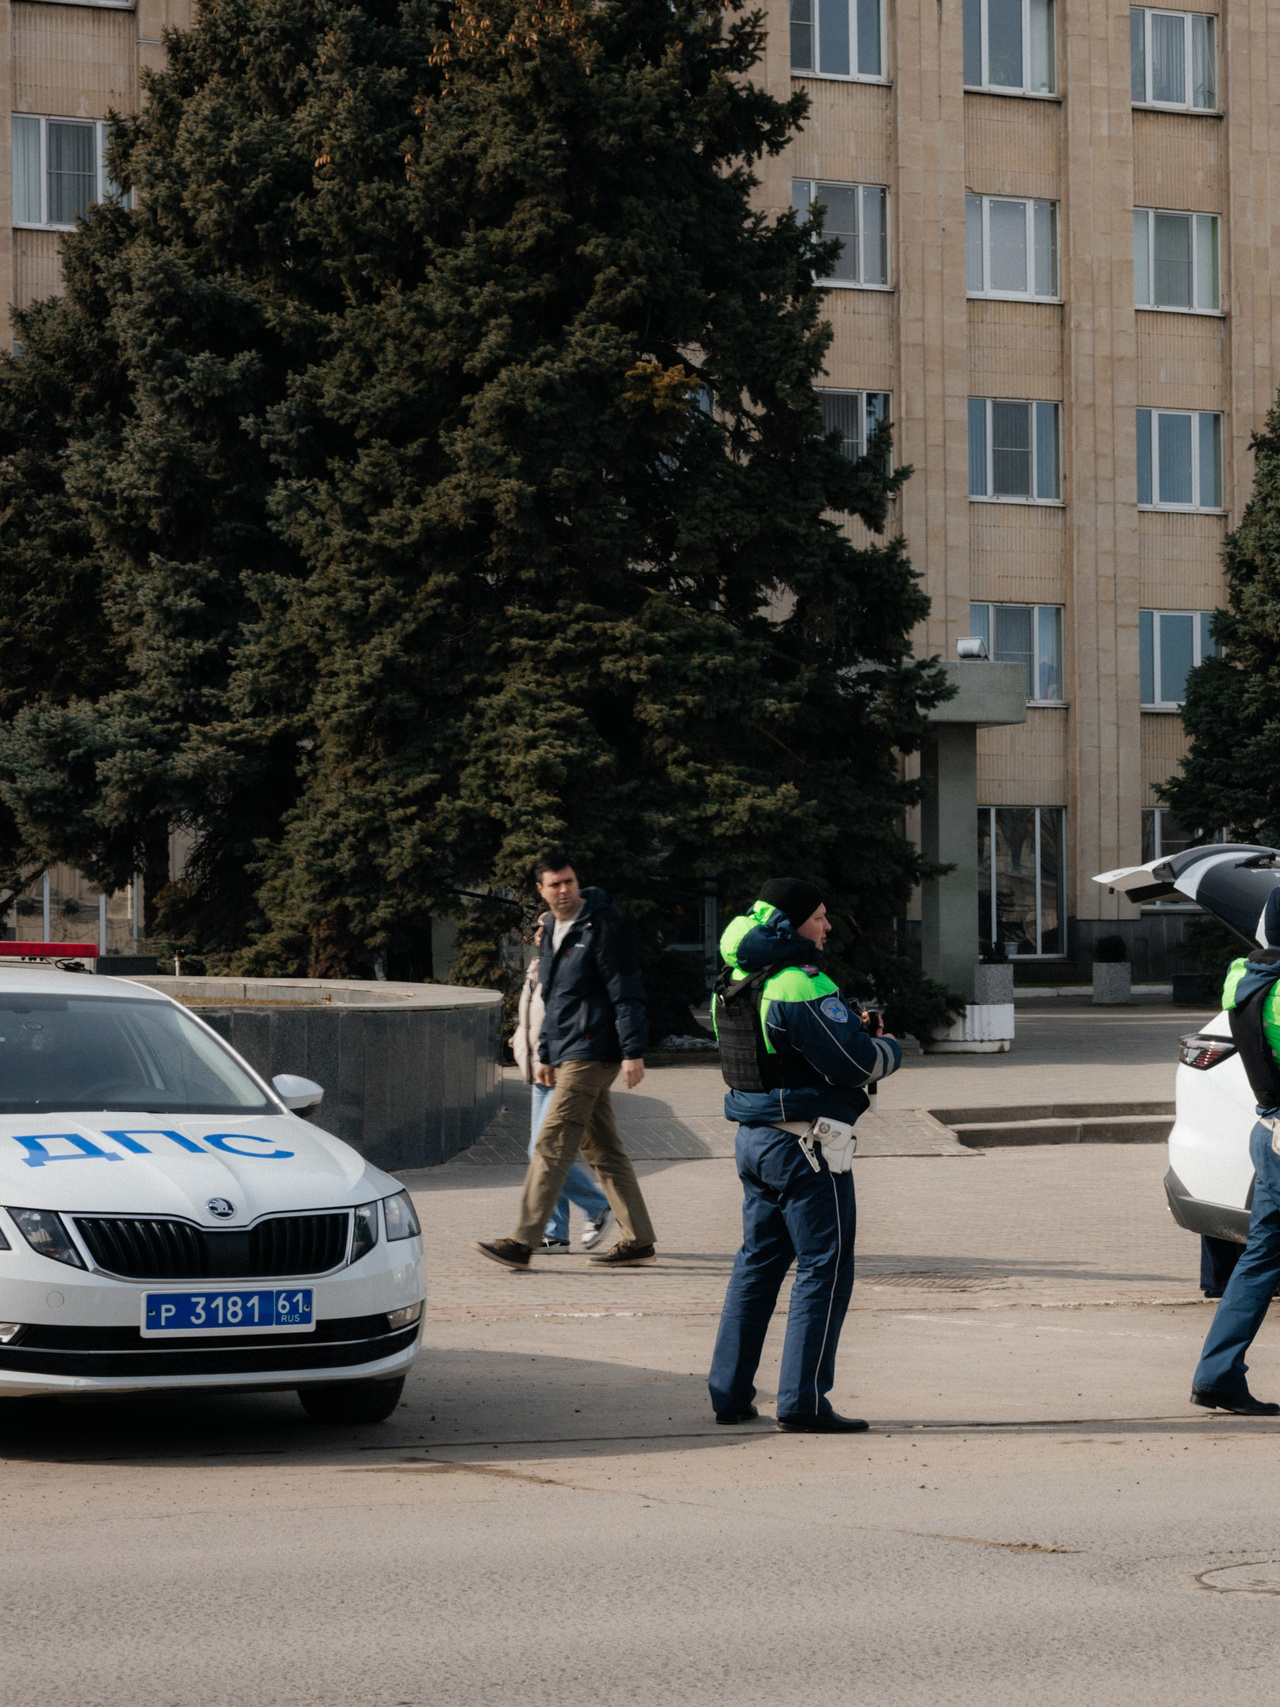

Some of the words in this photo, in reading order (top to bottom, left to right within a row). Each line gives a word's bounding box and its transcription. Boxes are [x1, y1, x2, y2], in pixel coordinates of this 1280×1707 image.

[12, 1130, 295, 1168] ДПС
[190, 1295, 259, 1324] 3181
[277, 1293, 303, 1314] 61
[281, 1314, 300, 1323] RUS
